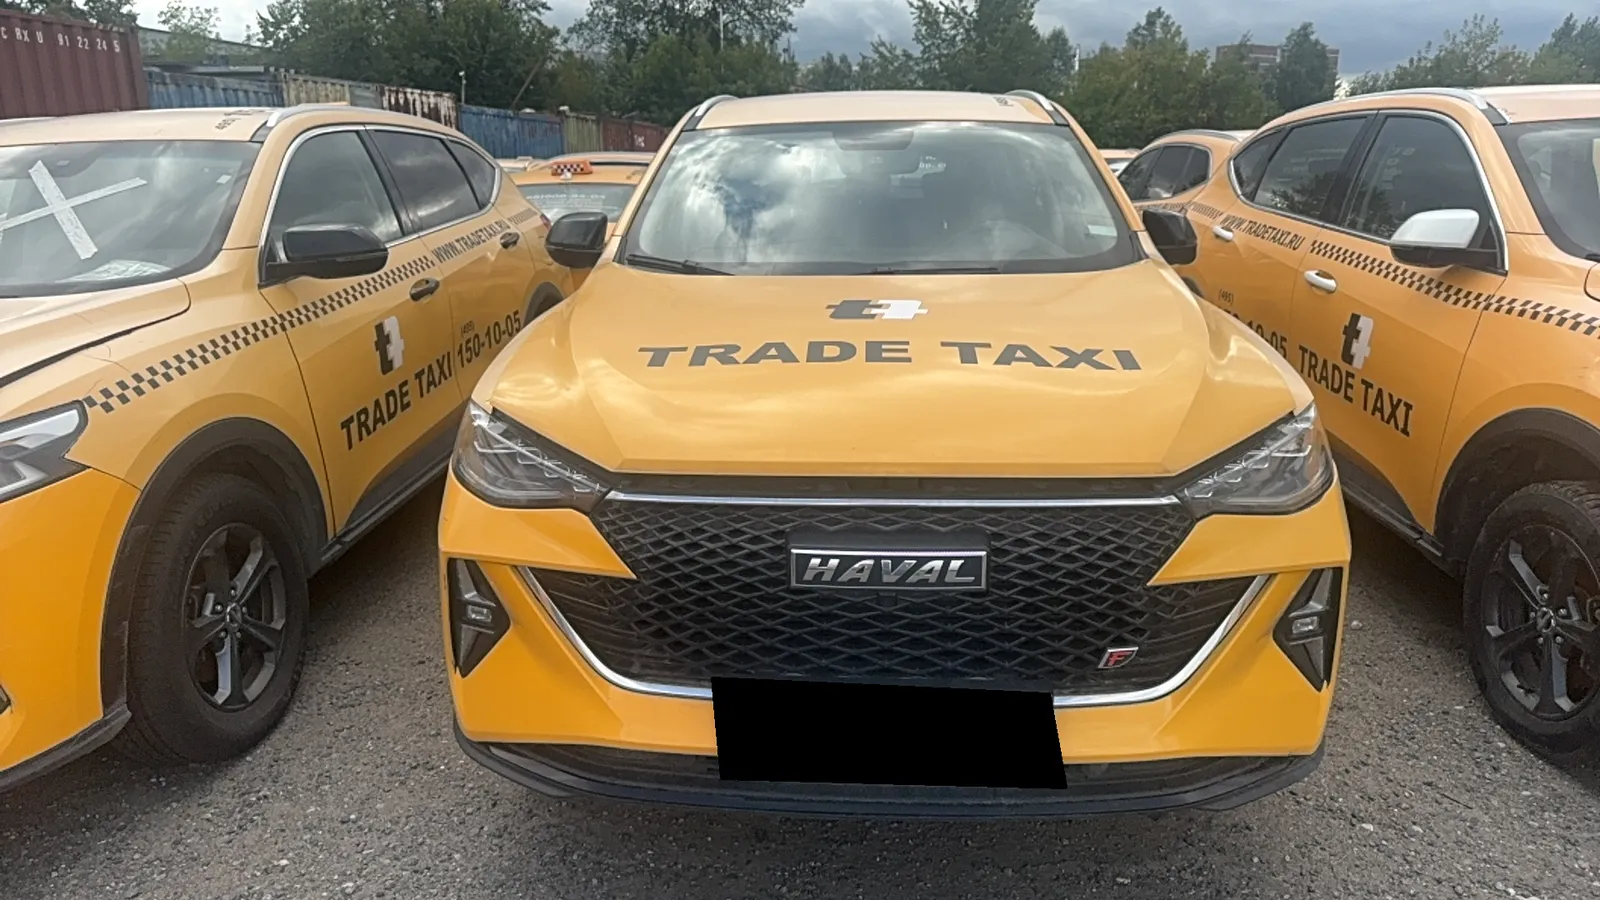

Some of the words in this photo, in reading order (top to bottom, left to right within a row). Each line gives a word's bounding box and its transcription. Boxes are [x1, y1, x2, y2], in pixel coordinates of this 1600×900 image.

[1220, 214, 1306, 251] WWW.TRADETAXI.RU
[458, 309, 522, 368] 150-10-05
[638, 340, 913, 367] TRADE
[940, 341, 1143, 371] TAXI
[340, 379, 412, 451] TRADE
[414, 351, 453, 398] TAXI
[1298, 344, 1356, 403] TRADE
[1361, 378, 1414, 438] TAXI
[802, 557, 976, 584] HAVAL
